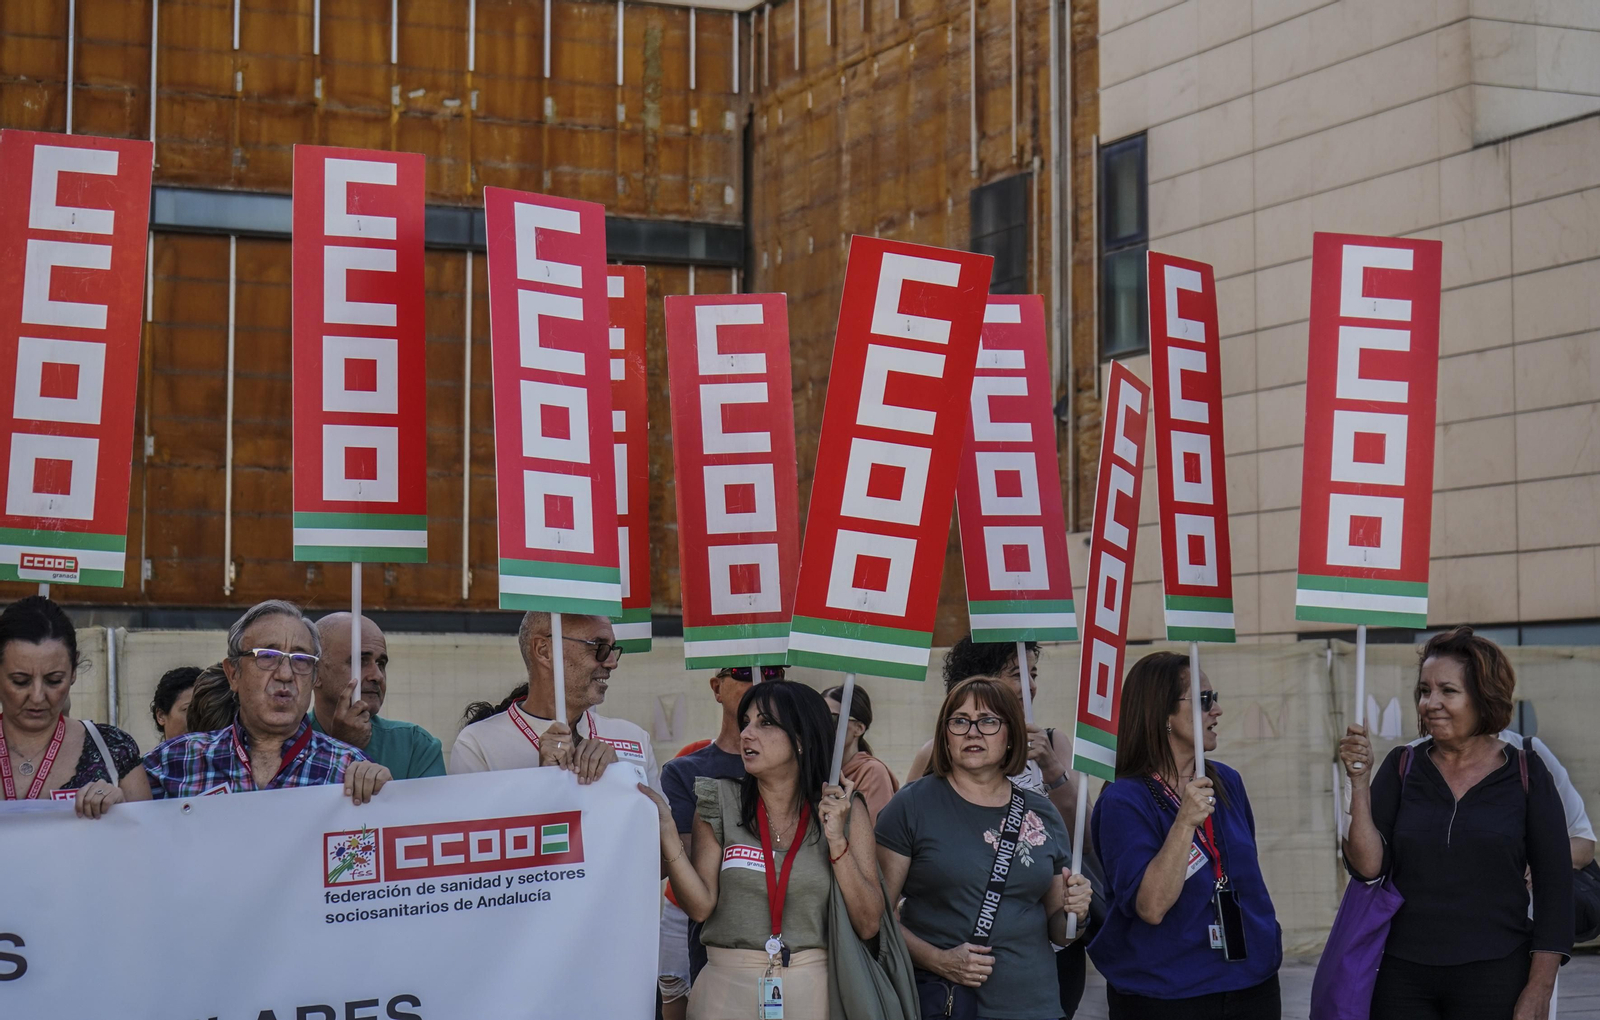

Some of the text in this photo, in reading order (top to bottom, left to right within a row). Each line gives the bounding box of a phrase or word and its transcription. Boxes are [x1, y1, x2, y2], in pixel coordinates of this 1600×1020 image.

[5, 144, 119, 520] CCOO
[323, 157, 398, 502] CCOO
[514, 201, 594, 554] CCOO
[695, 303, 782, 616] CCOO
[826, 252, 962, 617] CCOO
[1164, 264, 1218, 587] CCOO
[1326, 244, 1414, 570] CCOO
[23, 556, 65, 569] CCOO
[1087, 378, 1142, 721] CCOO
[324, 868, 586, 904] federación de sanidad y sectores
[325, 888, 551, 924] sociosanitarios de Andalucía
[349, 869, 373, 880] fss
[395, 826, 535, 869] CCOO
[725, 848, 760, 859] CCOO
[973, 793, 1025, 938] BIMBA BIMBA BIMBA
